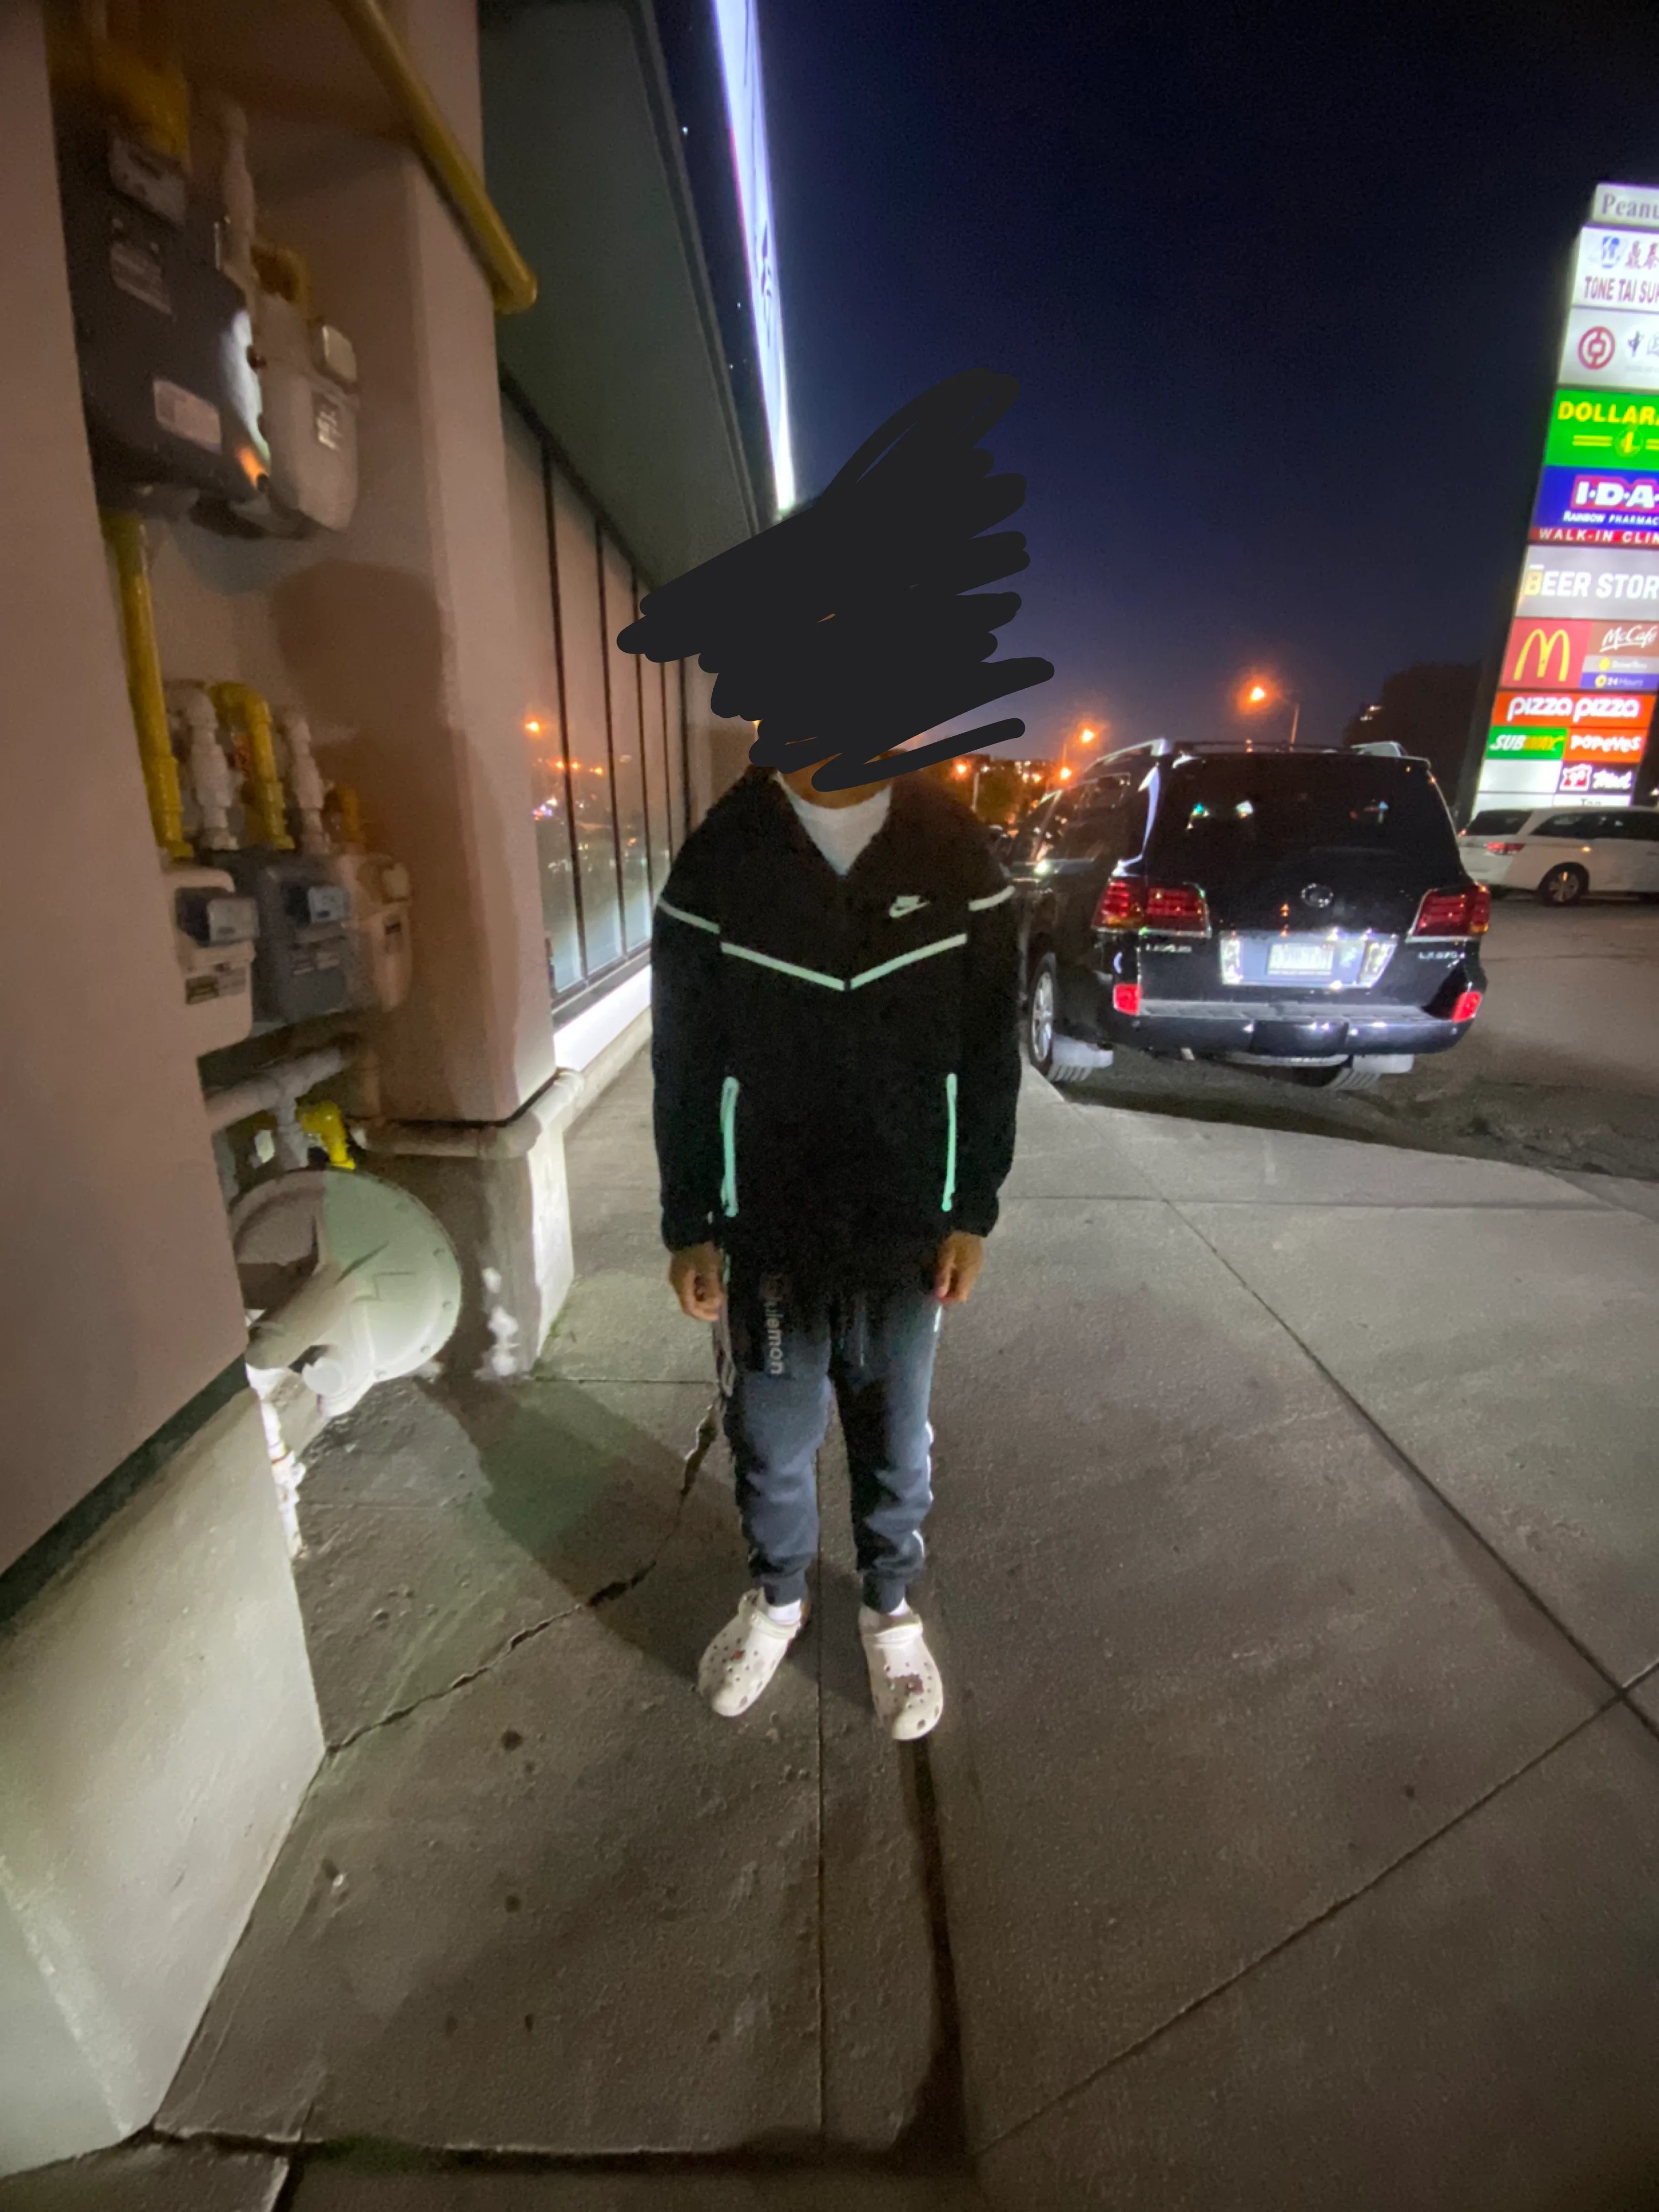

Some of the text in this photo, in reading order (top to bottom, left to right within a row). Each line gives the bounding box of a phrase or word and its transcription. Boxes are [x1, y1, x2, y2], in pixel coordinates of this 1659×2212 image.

[1584, 275, 1615, 300] TONE
[1618, 279, 1637, 302] TAI
[1558, 401, 1659, 426] DOLLAR
[1539, 527, 1613, 542] WALK-IN
[1524, 570, 1659, 600] BEER STOR
[1507, 697, 1640, 723] pizza pizza
